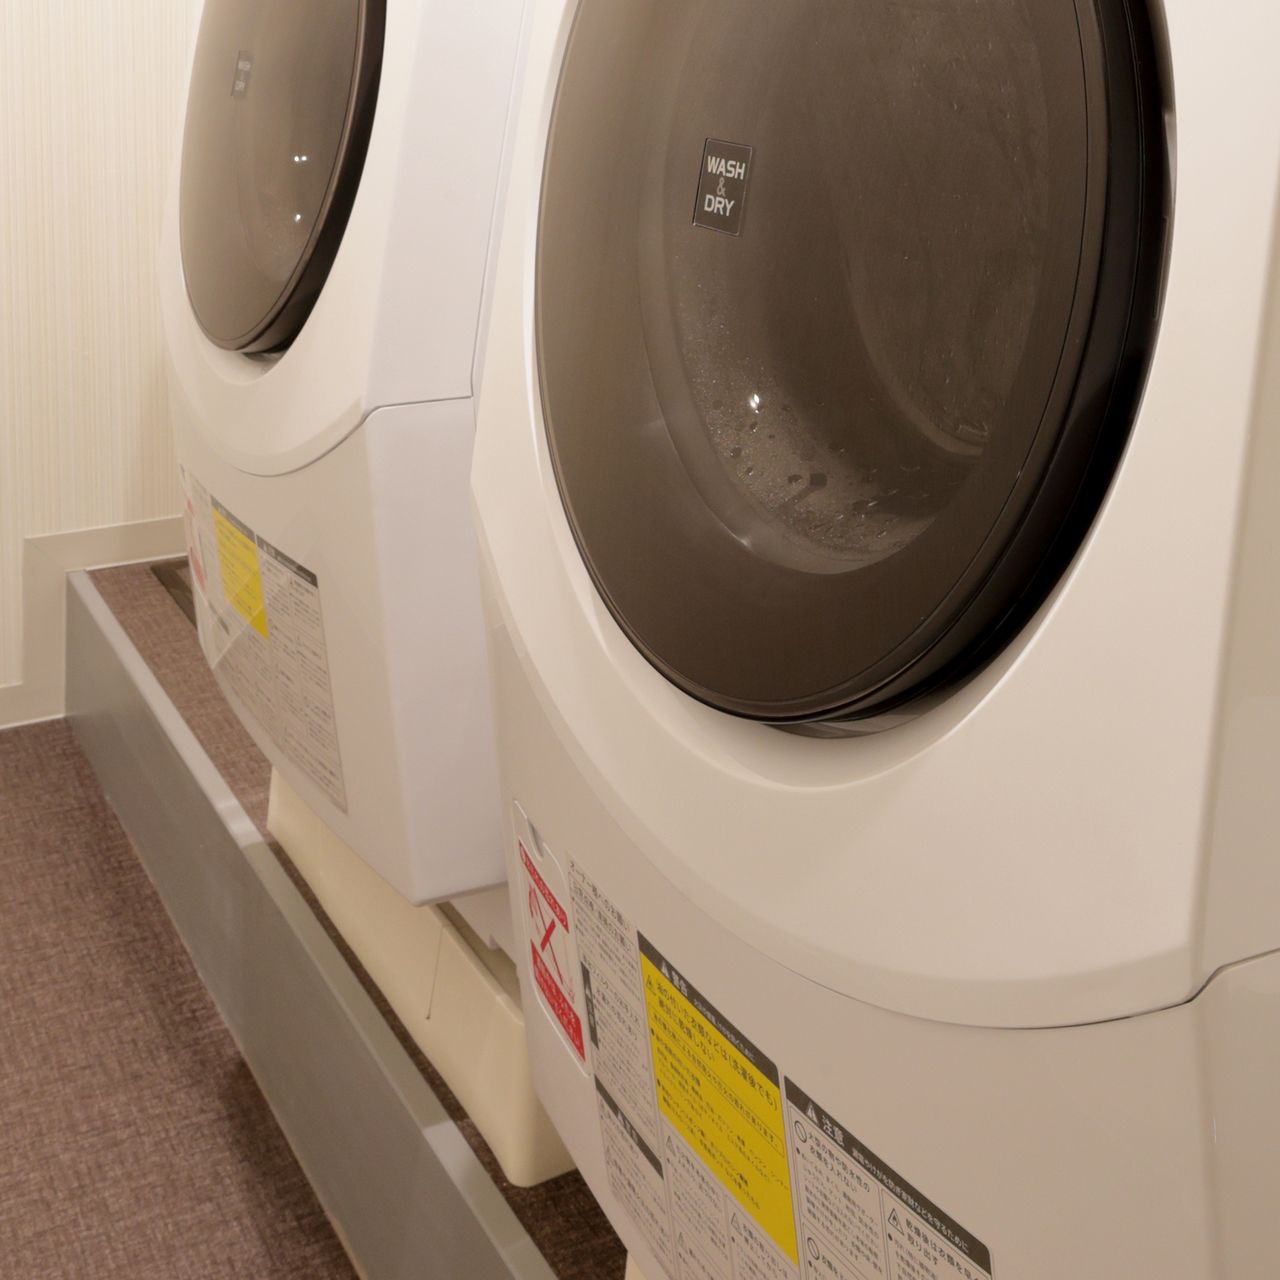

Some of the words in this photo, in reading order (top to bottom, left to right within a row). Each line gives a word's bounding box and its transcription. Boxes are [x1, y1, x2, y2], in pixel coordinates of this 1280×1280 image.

[707, 155, 745, 180] WASH
[716, 177, 726, 197] &
[704, 194, 735, 217] DRY
[822, 1114, 845, 1149] 注意
